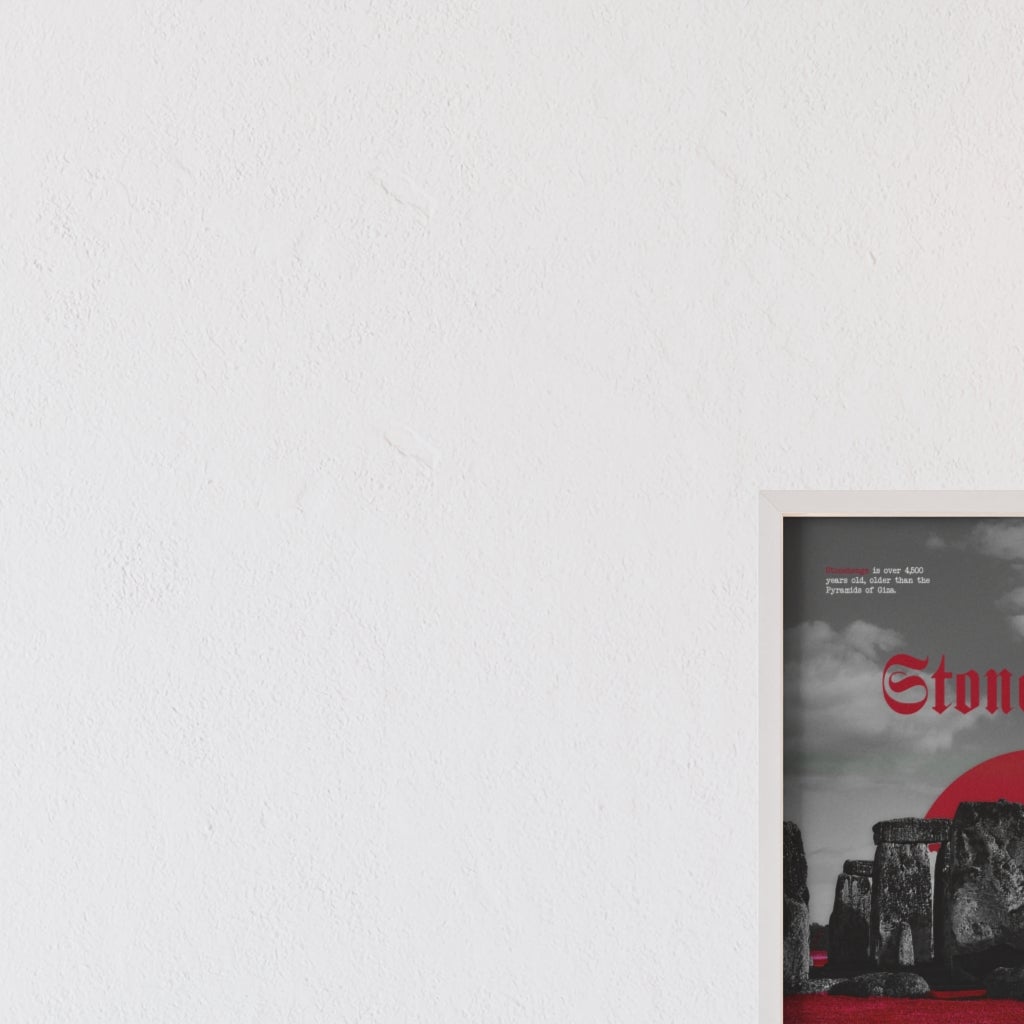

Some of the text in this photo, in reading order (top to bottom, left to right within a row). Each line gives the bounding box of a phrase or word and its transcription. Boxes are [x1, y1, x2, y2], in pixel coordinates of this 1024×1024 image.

[873, 566, 880, 574] is
[826, 576, 930, 585] years old, older than the
[826, 586, 862, 595] Pyramids
[865, 586, 874, 594] of
